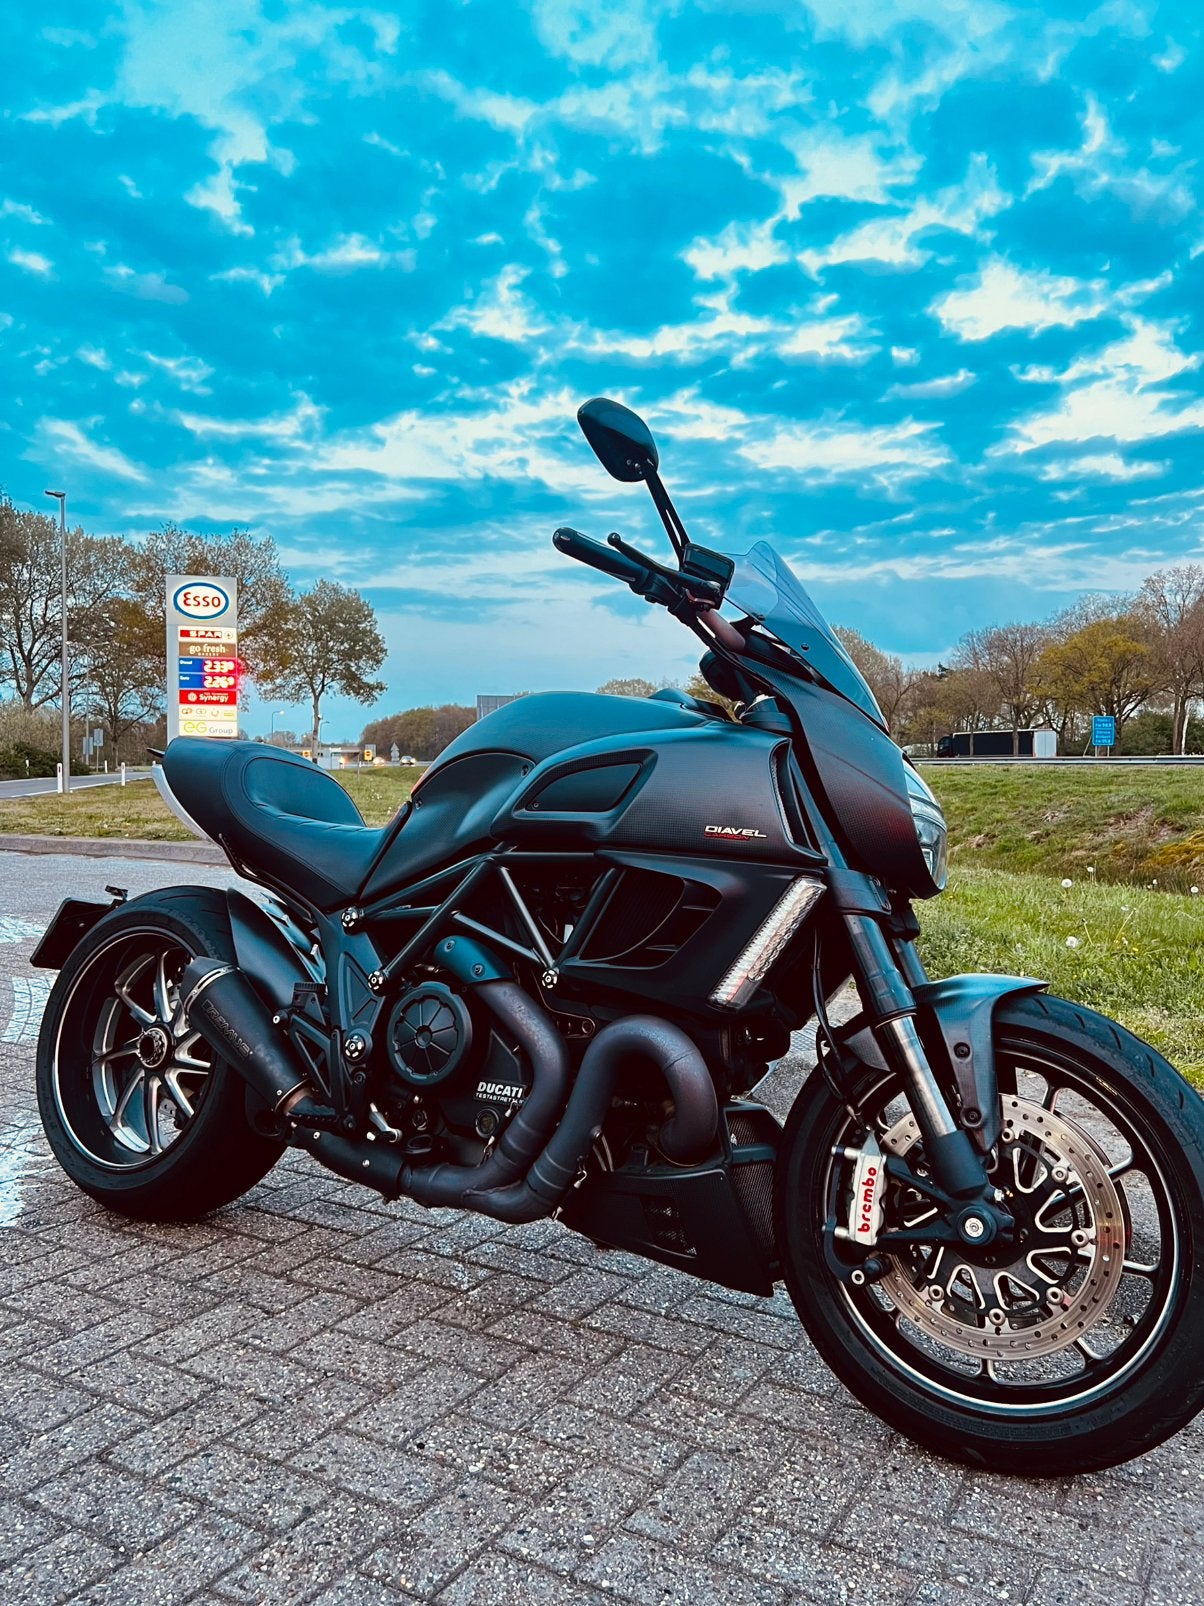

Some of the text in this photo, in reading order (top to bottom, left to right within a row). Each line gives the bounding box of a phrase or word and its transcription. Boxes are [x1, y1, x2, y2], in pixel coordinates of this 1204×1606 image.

[189, 630, 222, 638] SPAR
[189, 645, 201, 655] go
[203, 643, 226, 653] fresh
[199, 693, 229, 703] Synergy
[208, 726, 234, 735] Group
[704, 825, 768, 838] DIAVEL
[477, 1081, 523, 1098] DUCATI
[857, 1167, 877, 1233] brembo
